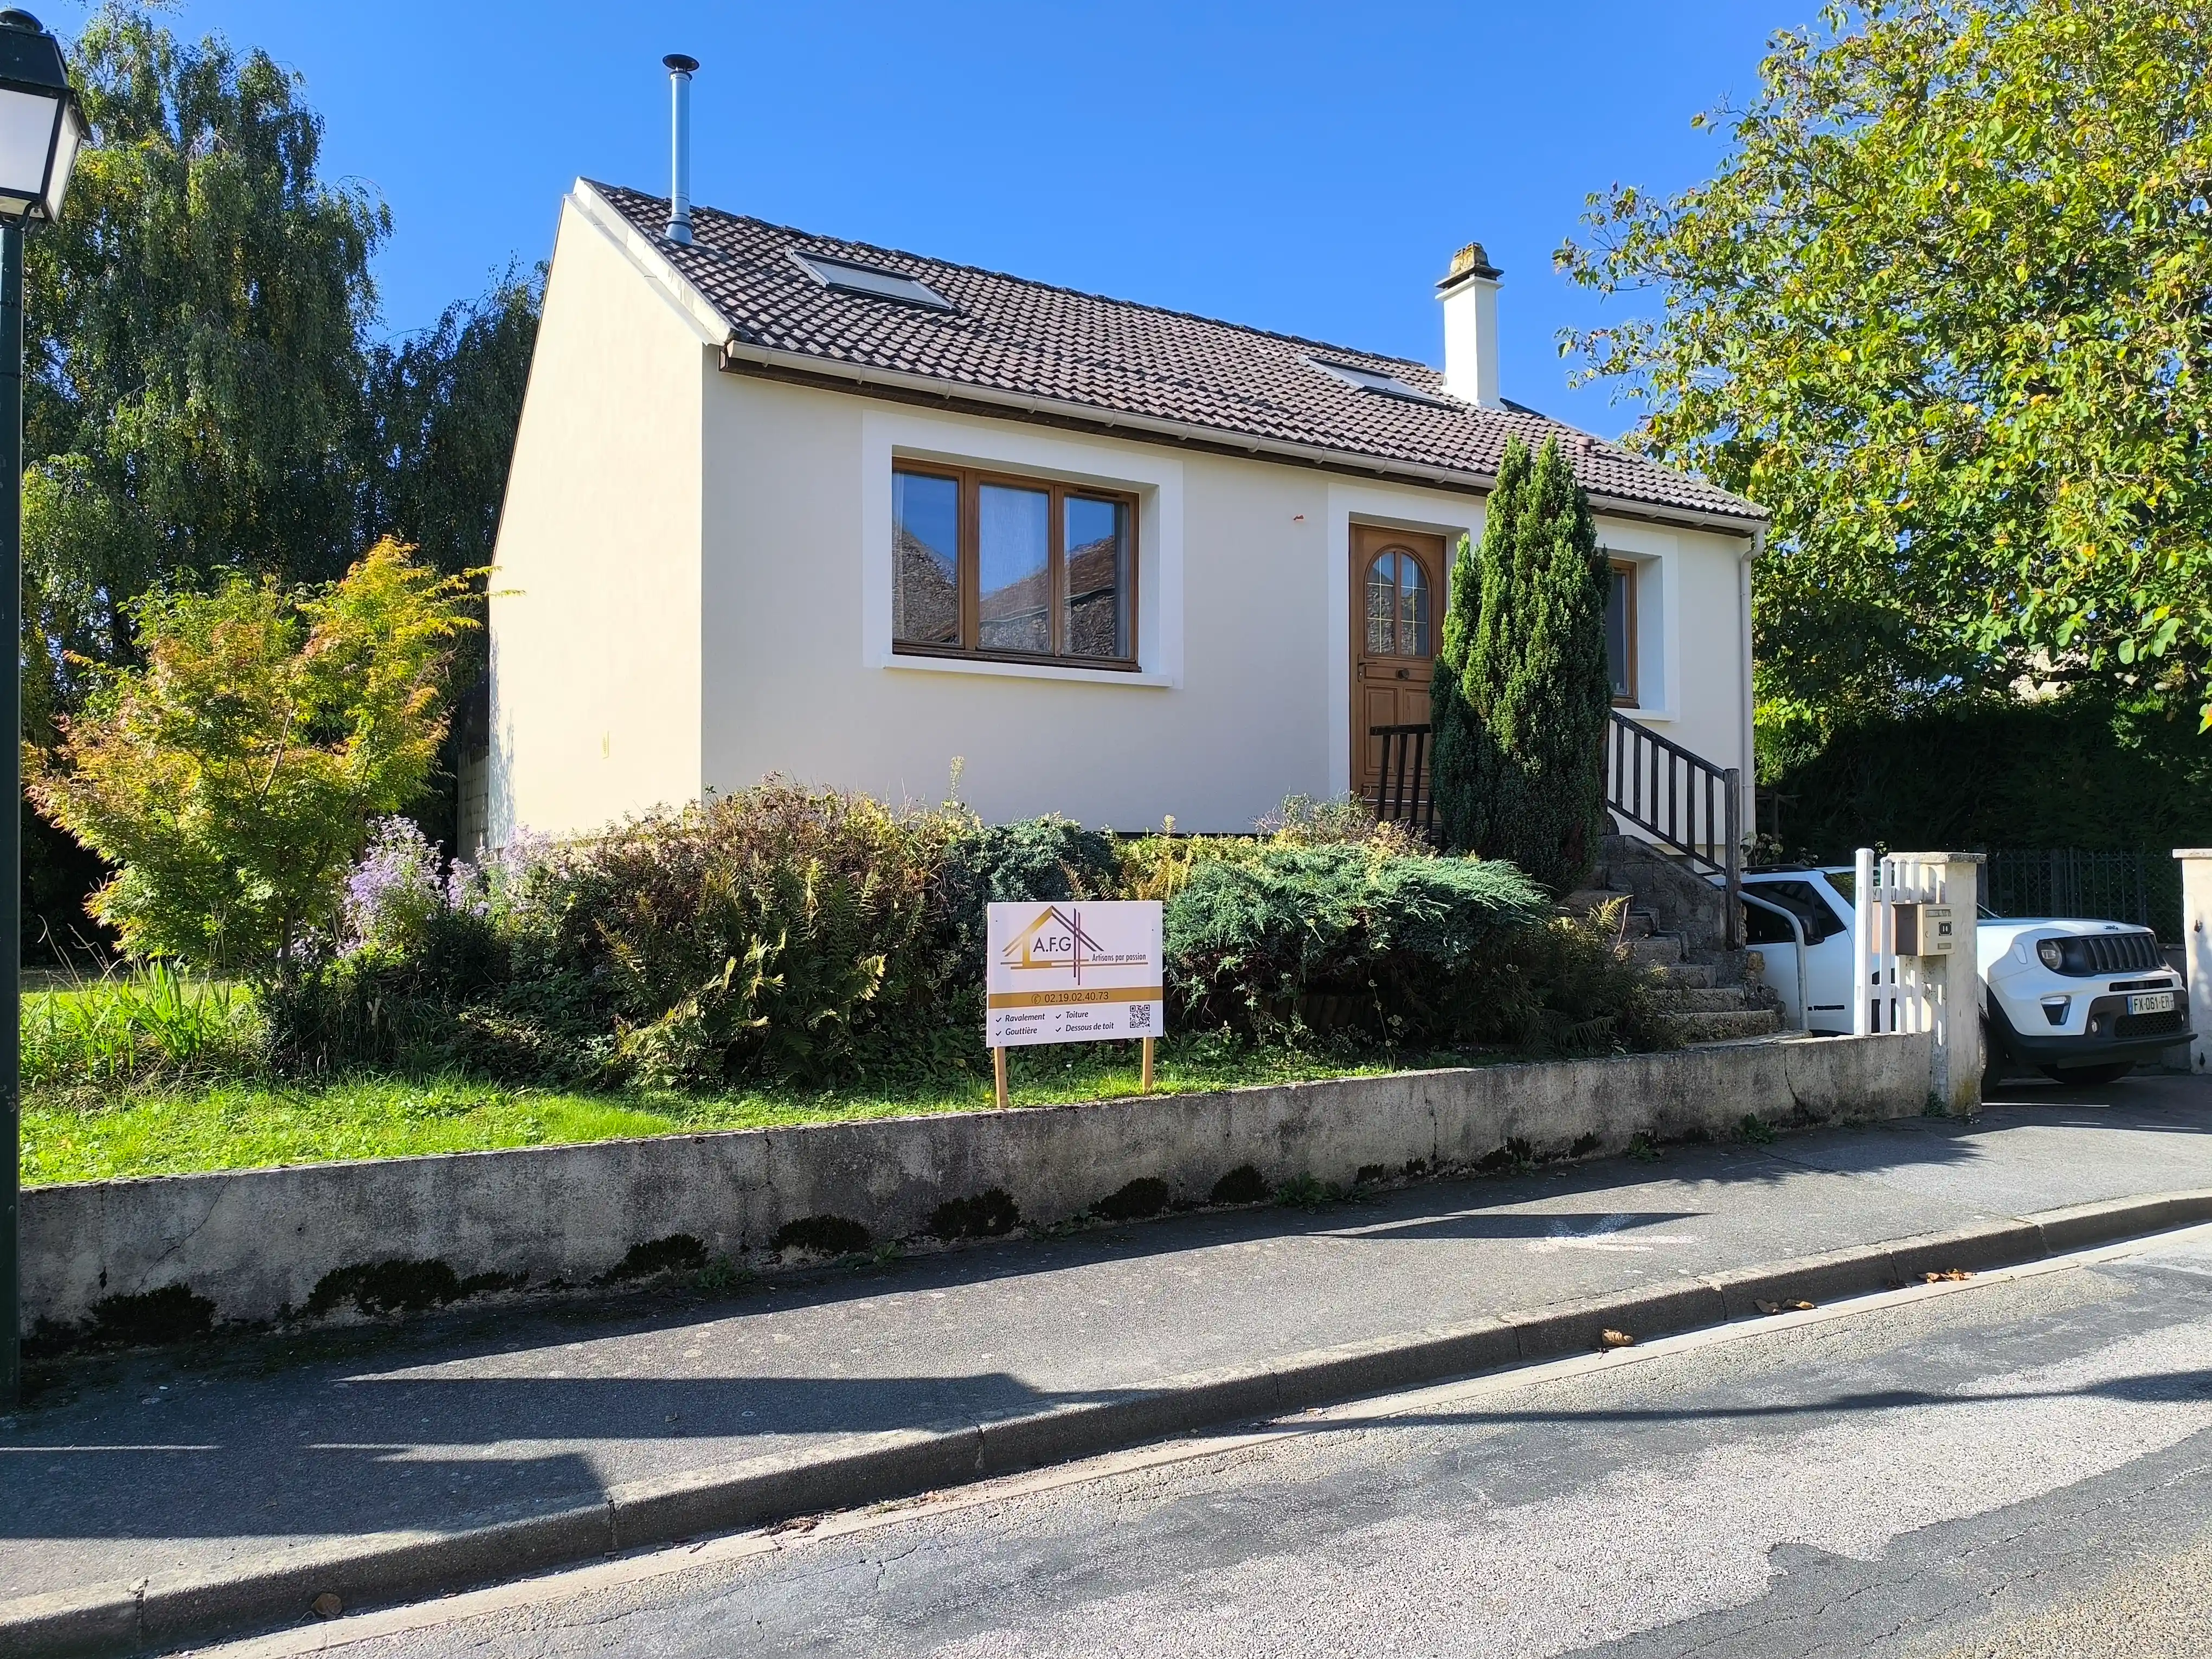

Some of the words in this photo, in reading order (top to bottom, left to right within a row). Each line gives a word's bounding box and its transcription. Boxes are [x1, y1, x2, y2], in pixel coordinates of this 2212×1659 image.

[1033, 937, 1071, 952] A.F.G
[1092, 954, 1114, 962] Artisans
[1126, 953, 1146, 962] passion
[1044, 992, 1109, 1003] 02.19.02.40.73
[1005, 1013, 1045, 1022] Ravalement
[1005, 1027, 1038, 1036] Gouttière
